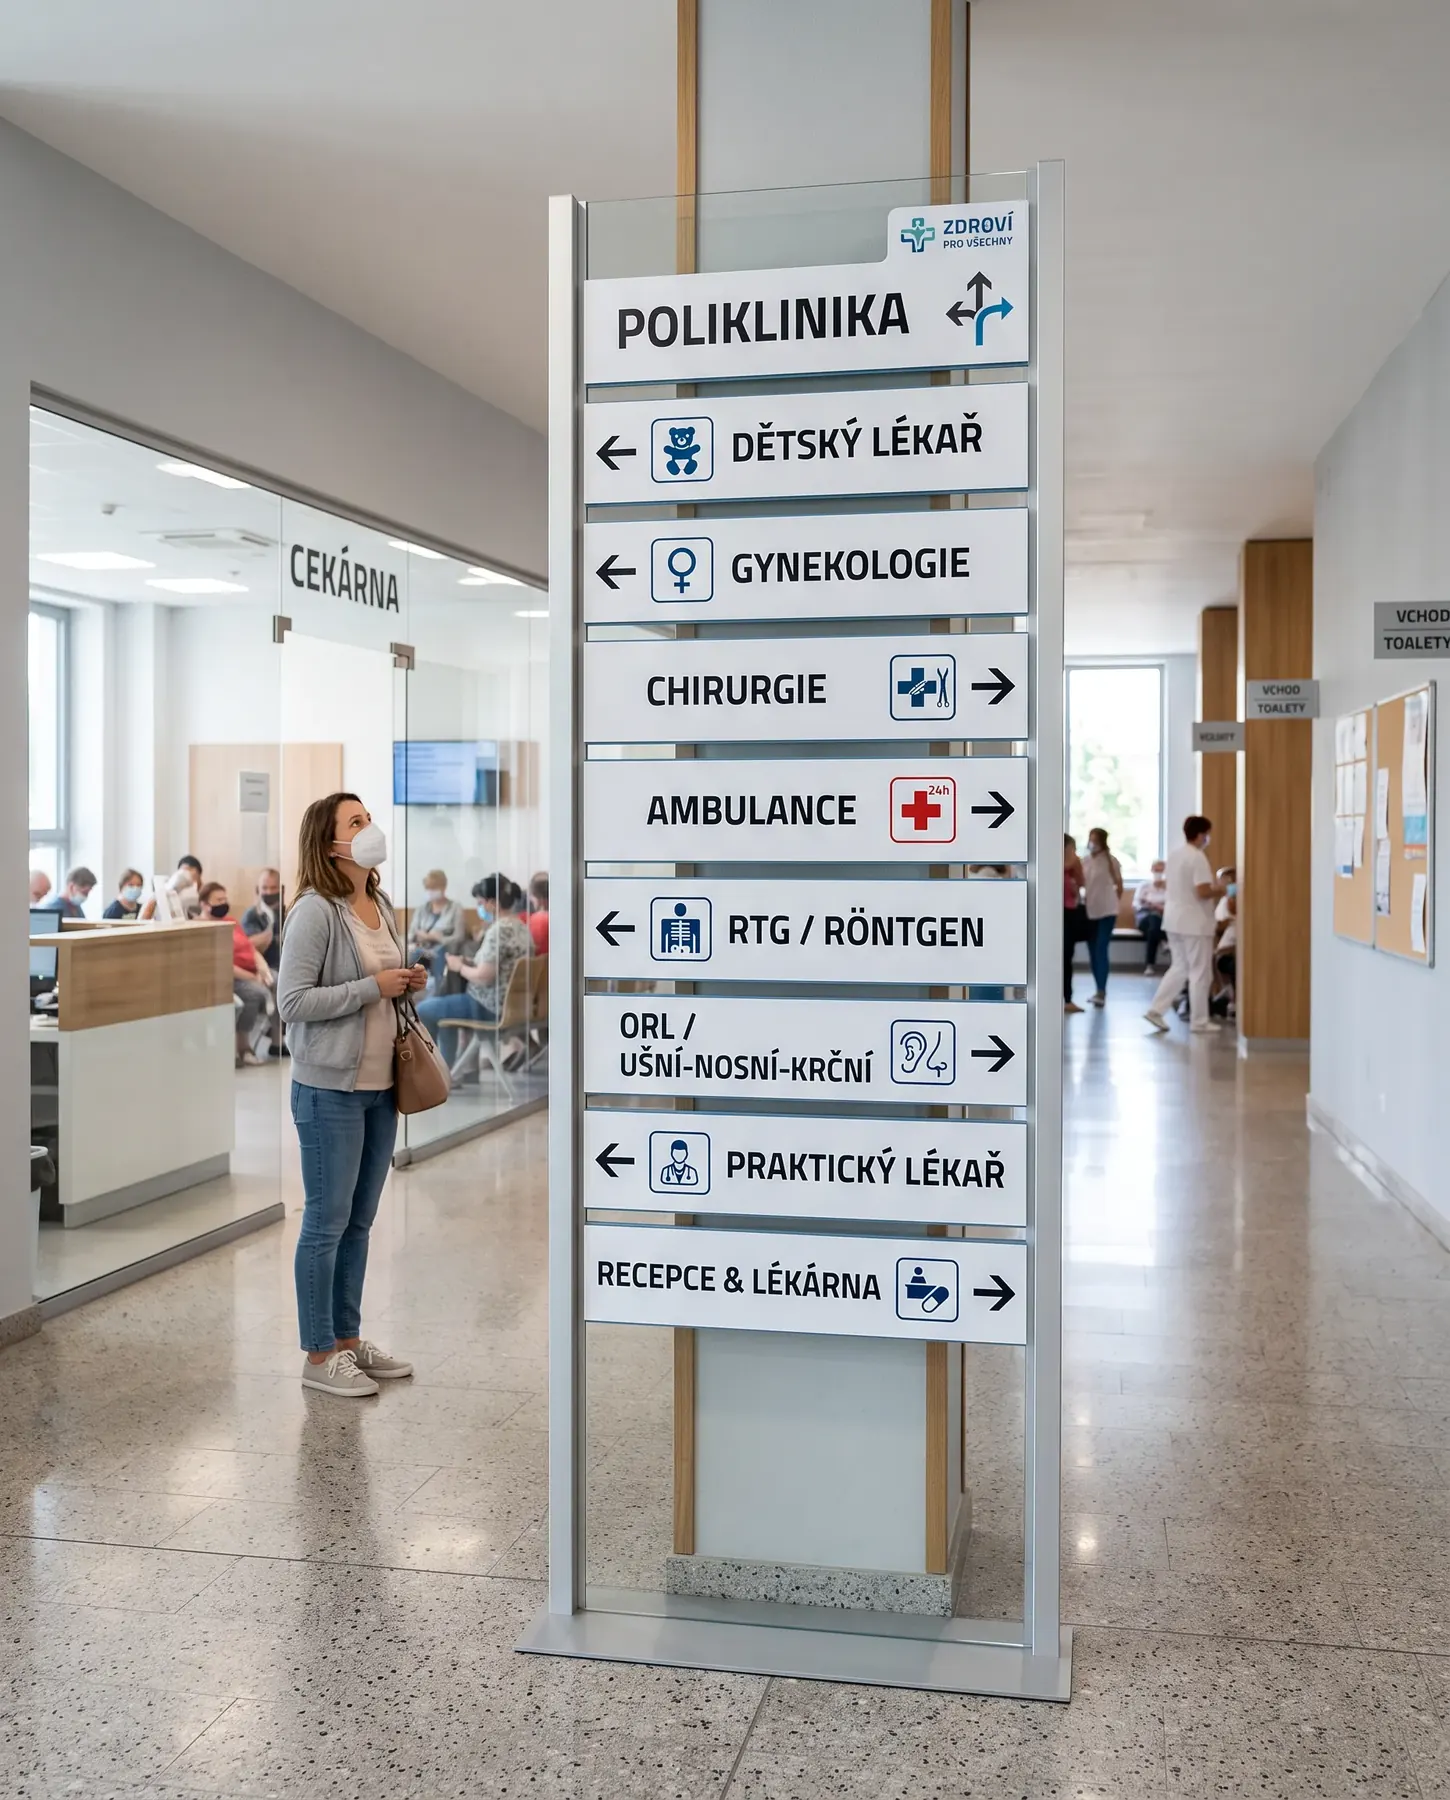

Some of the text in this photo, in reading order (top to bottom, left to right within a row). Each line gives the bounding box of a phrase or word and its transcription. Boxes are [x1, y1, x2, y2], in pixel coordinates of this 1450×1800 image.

[943, 211, 1014, 235] ZDROVÍ
[943, 236, 1013, 249] PRO VŠECHNY
[618, 292, 909, 349] POLIKLINIKA
[732, 411, 982, 463] DĚTSKÝ LÉKAŘ
[290, 543, 399, 613] CEKÁRNA
[731, 547, 970, 584] GYNEKOLOGIE
[1396, 609, 1450, 623] VCHOD
[1383, 636, 1450, 650] TOALETY
[647, 673, 827, 706] CHIRURGIE
[1262, 685, 1301, 696] VCHOD
[1257, 703, 1307, 714] TOALETY
[928, 785, 950, 796] 24h
[646, 794, 857, 826] AMBULANCE
[729, 906, 984, 948] RTG / RÖNTGEN
[620, 1012, 697, 1041] ORL /
[620, 1045, 874, 1083] UŠNÍ-NOSNÍ-KRČNÍ
[727, 1146, 1005, 1189] PRAKTICKÝ LÉKAŘ
[597, 1260, 881, 1301] RECEPCE & LÉKÁRNA
